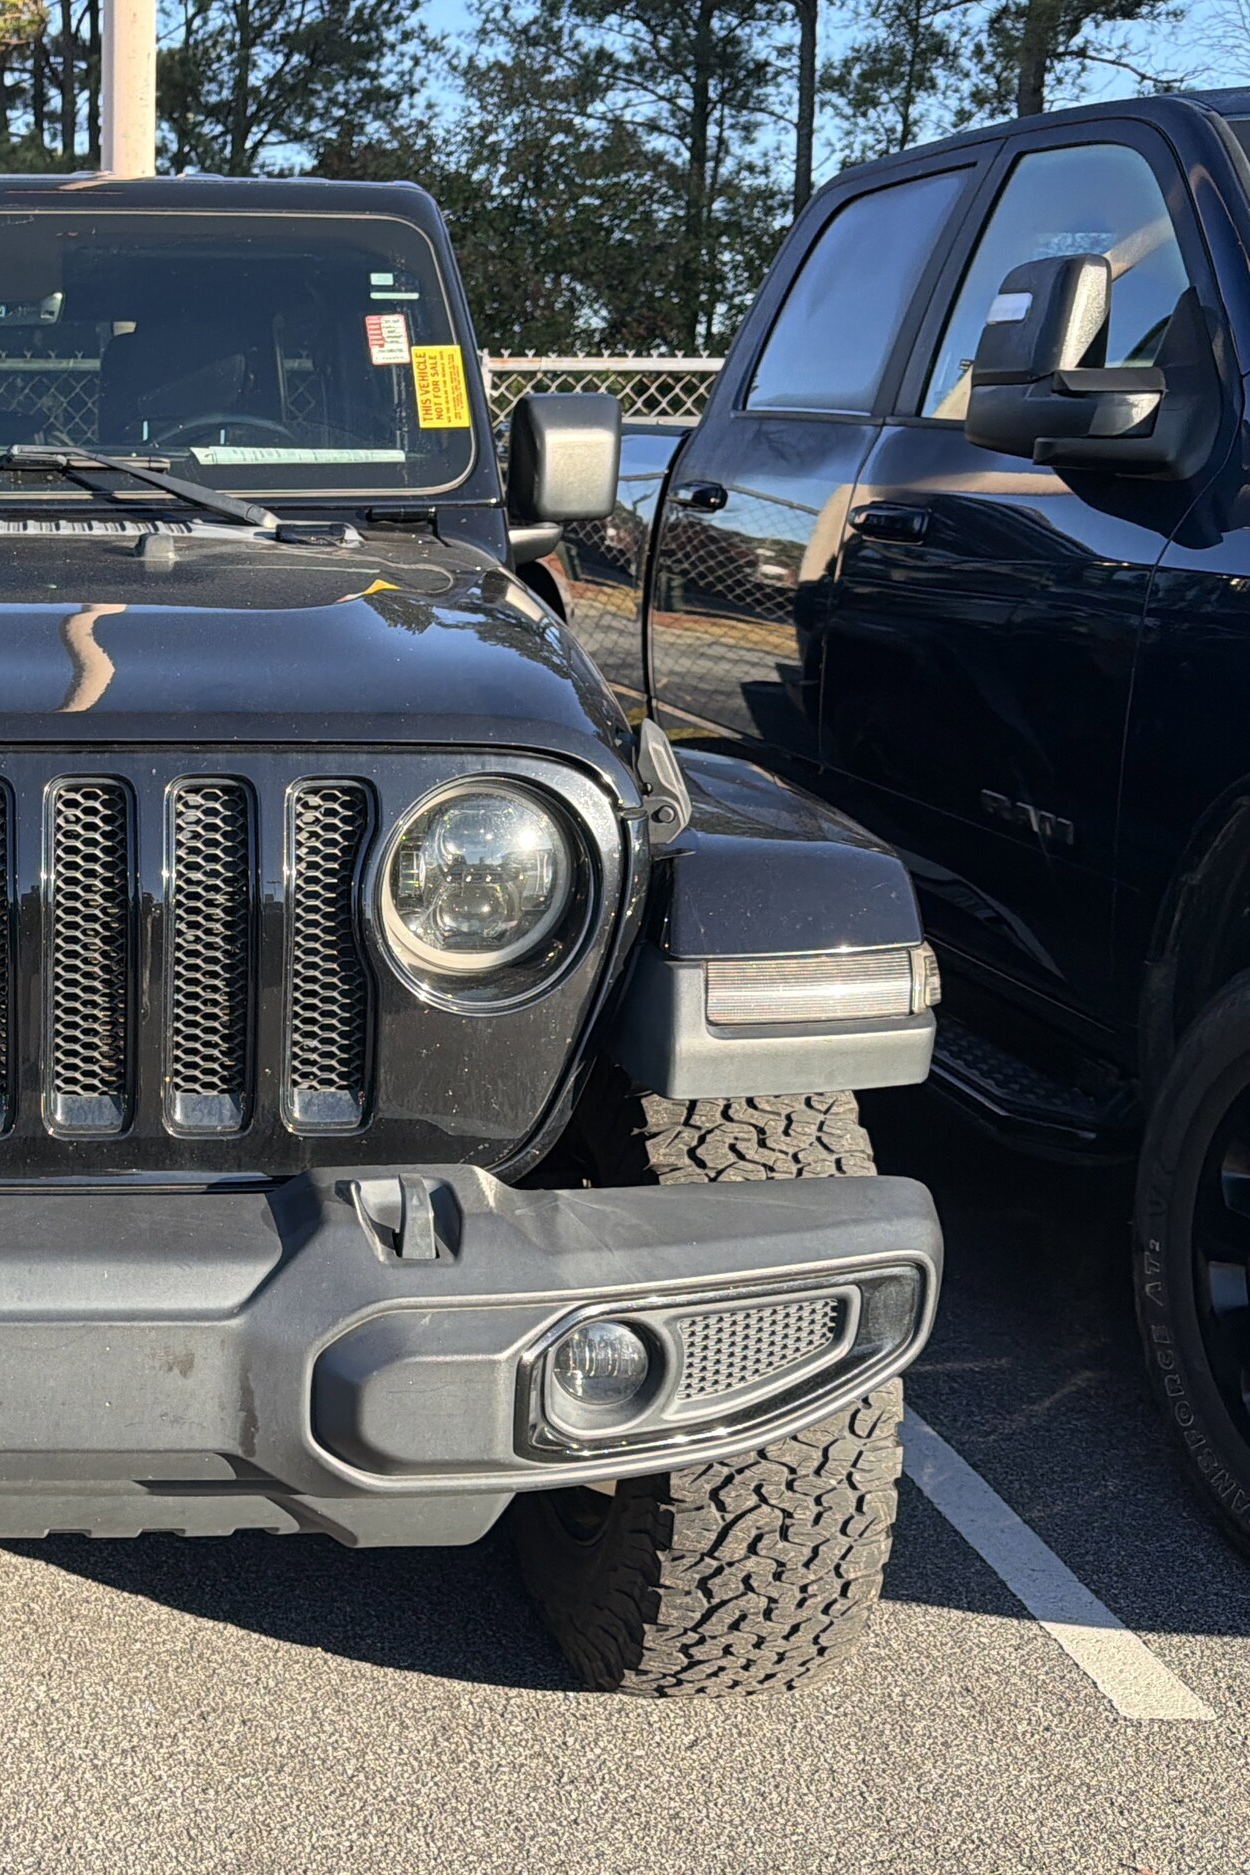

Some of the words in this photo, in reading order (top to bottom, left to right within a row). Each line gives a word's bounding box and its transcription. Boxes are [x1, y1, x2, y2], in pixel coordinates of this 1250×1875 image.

[415, 351, 430, 396] VEHICLE
[428, 354, 439, 377] SALE
[430, 379, 441, 398] FOR
[422, 398, 433, 422] THIS
[433, 401, 443, 420] NOT
[1150, 1324, 1250, 1522] ANSFORCE
